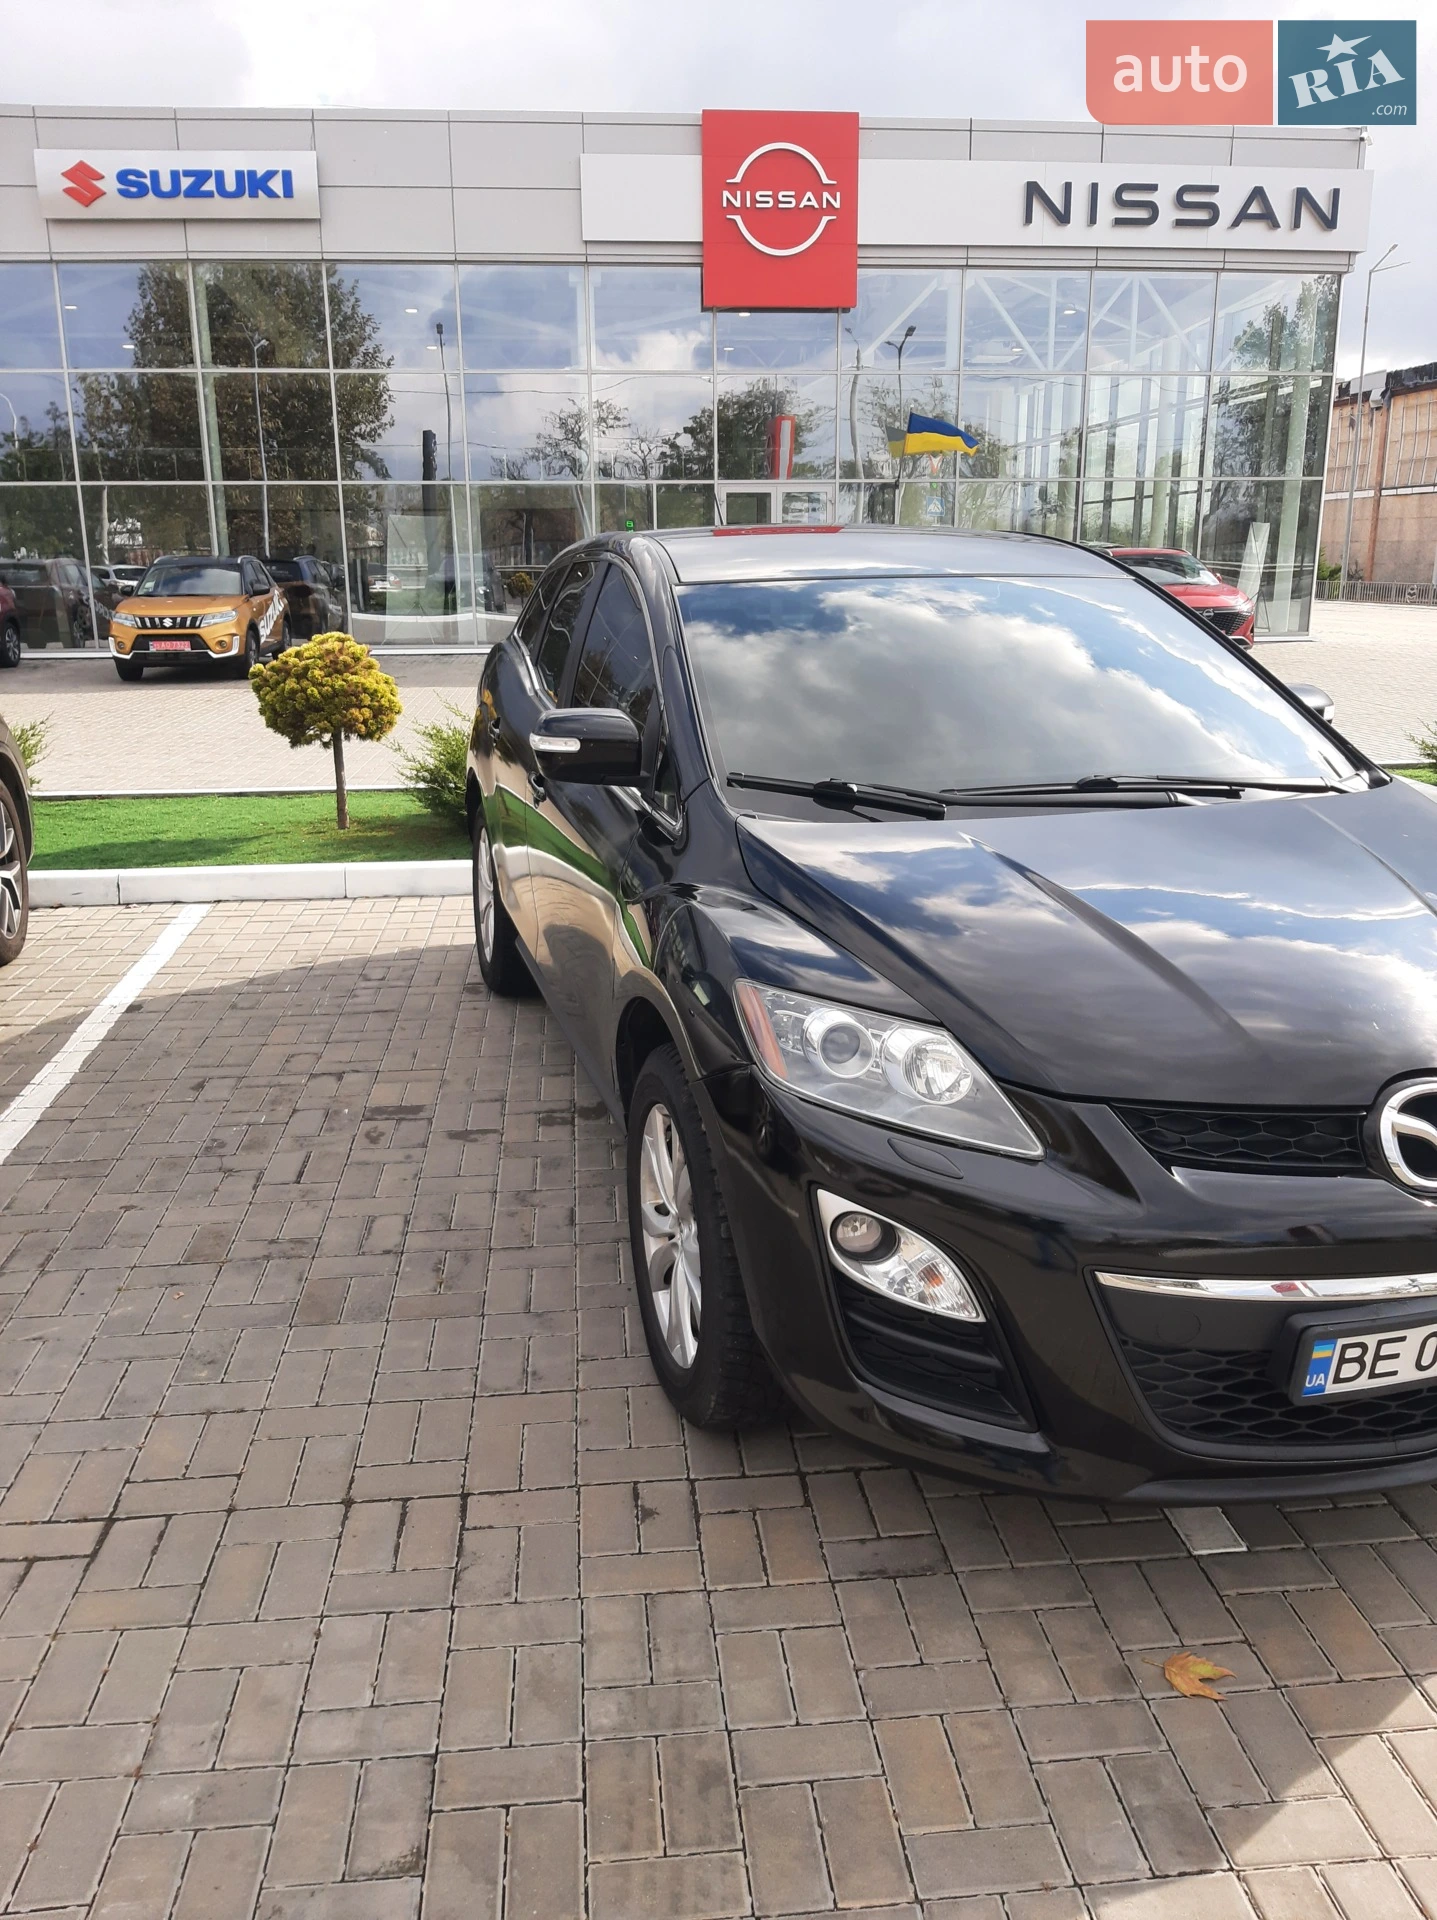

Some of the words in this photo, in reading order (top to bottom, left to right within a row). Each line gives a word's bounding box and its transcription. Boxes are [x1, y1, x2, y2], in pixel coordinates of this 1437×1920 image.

[115, 168, 294, 198] SUZUKI
[722, 190, 841, 209] NISSAN
[1023, 181, 1341, 231] NISSAN
[1332, 1335, 1408, 1385] BE
[1305, 1373, 1325, 1387] UA
